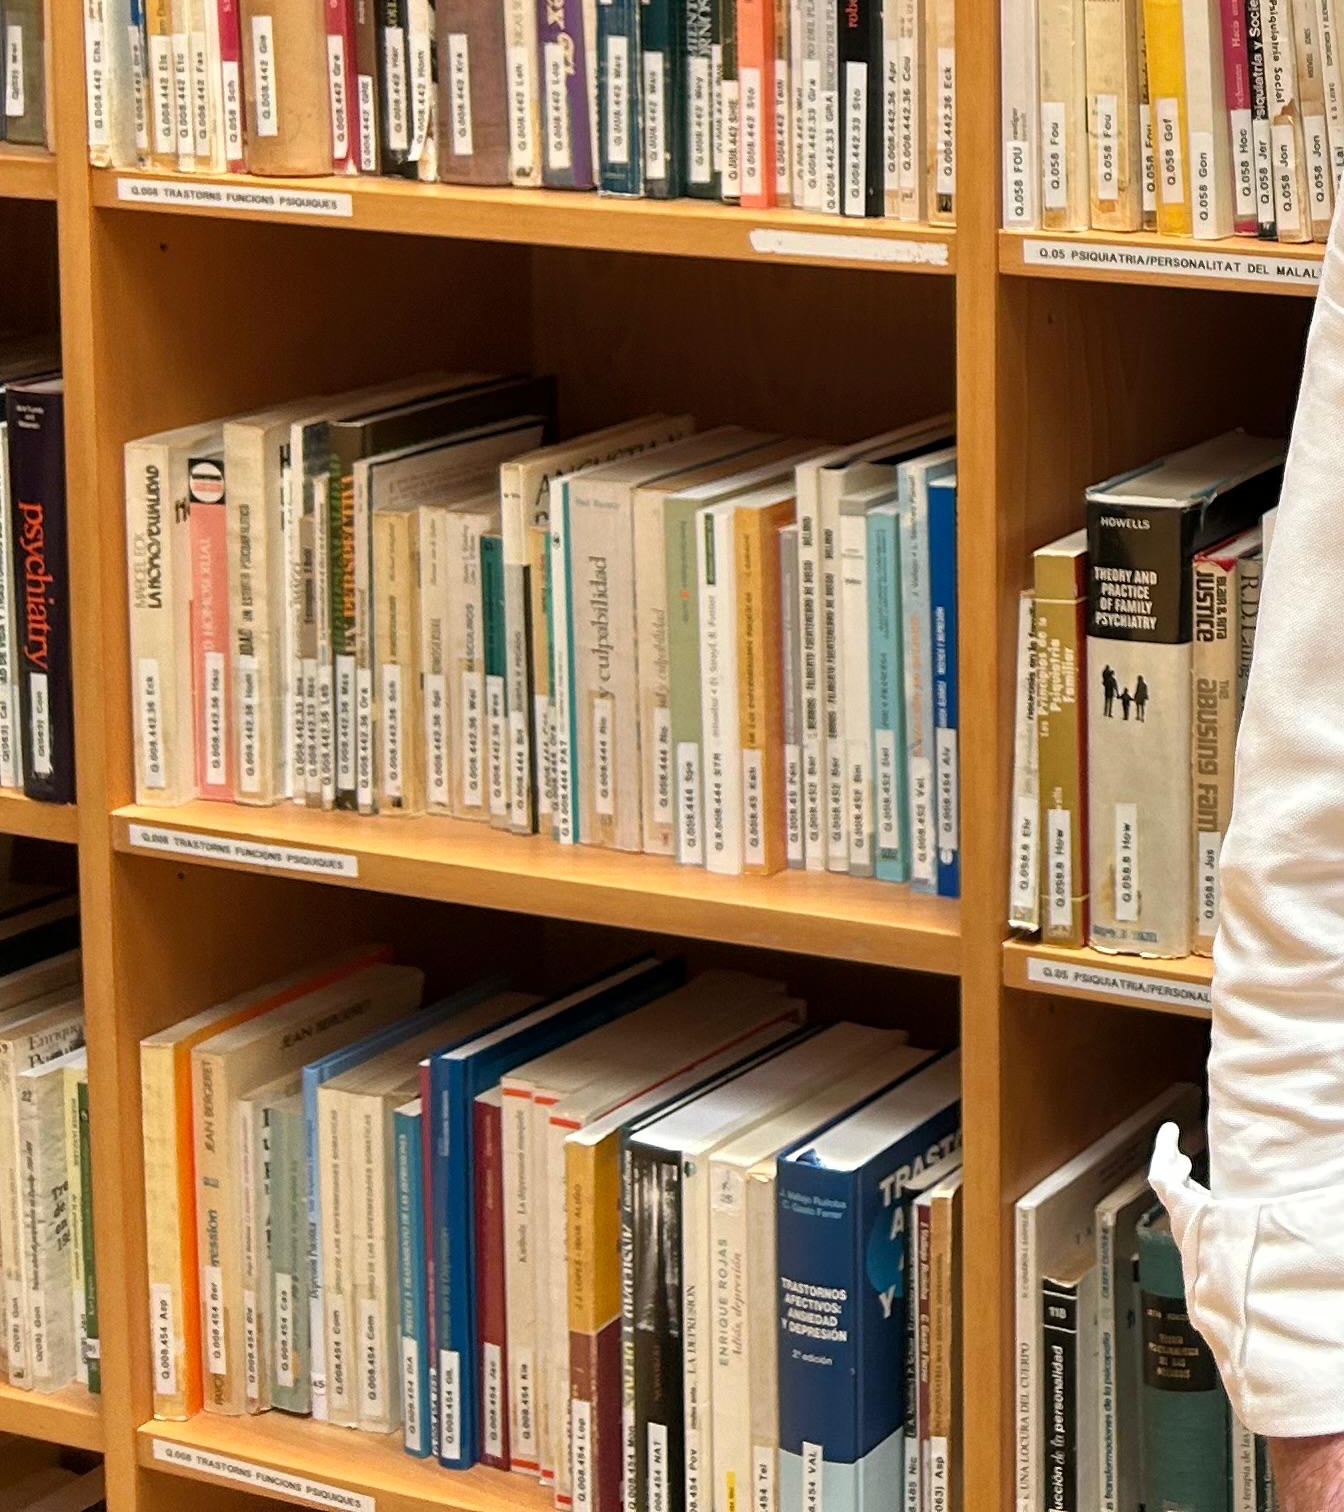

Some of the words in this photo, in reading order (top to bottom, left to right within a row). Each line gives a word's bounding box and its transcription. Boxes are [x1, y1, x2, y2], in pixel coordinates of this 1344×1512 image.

[1039, 247, 1065, 260] Q.05
[1071, 249, 1240, 273] PSIQUIATRIA/PERSONALITAT
[1247, 263, 1269, 275] DEL
[1276, 265, 1321, 279] MALAL
[1101, 516, 1150, 530] HOWELLS
[17, 499, 55, 670] psychiatry
[1094, 566, 1131, 582] THEORY
[1134, 573, 1157, 585] AND
[1101, 582, 1150, 598] PRACTICE
[1100, 597, 1115, 611] OF
[1117, 599, 1152, 614] FAMILY
[1095, 613, 1157, 630] PSYCHIATRY
[781, 1278, 847, 1301] TRASTORNOS
[196, 1454, 252, 1478] TRASTORNS
[254, 1468, 302, 1490] FUNCIONS
[305, 1484, 362, 1507] PSIQUIQUES
